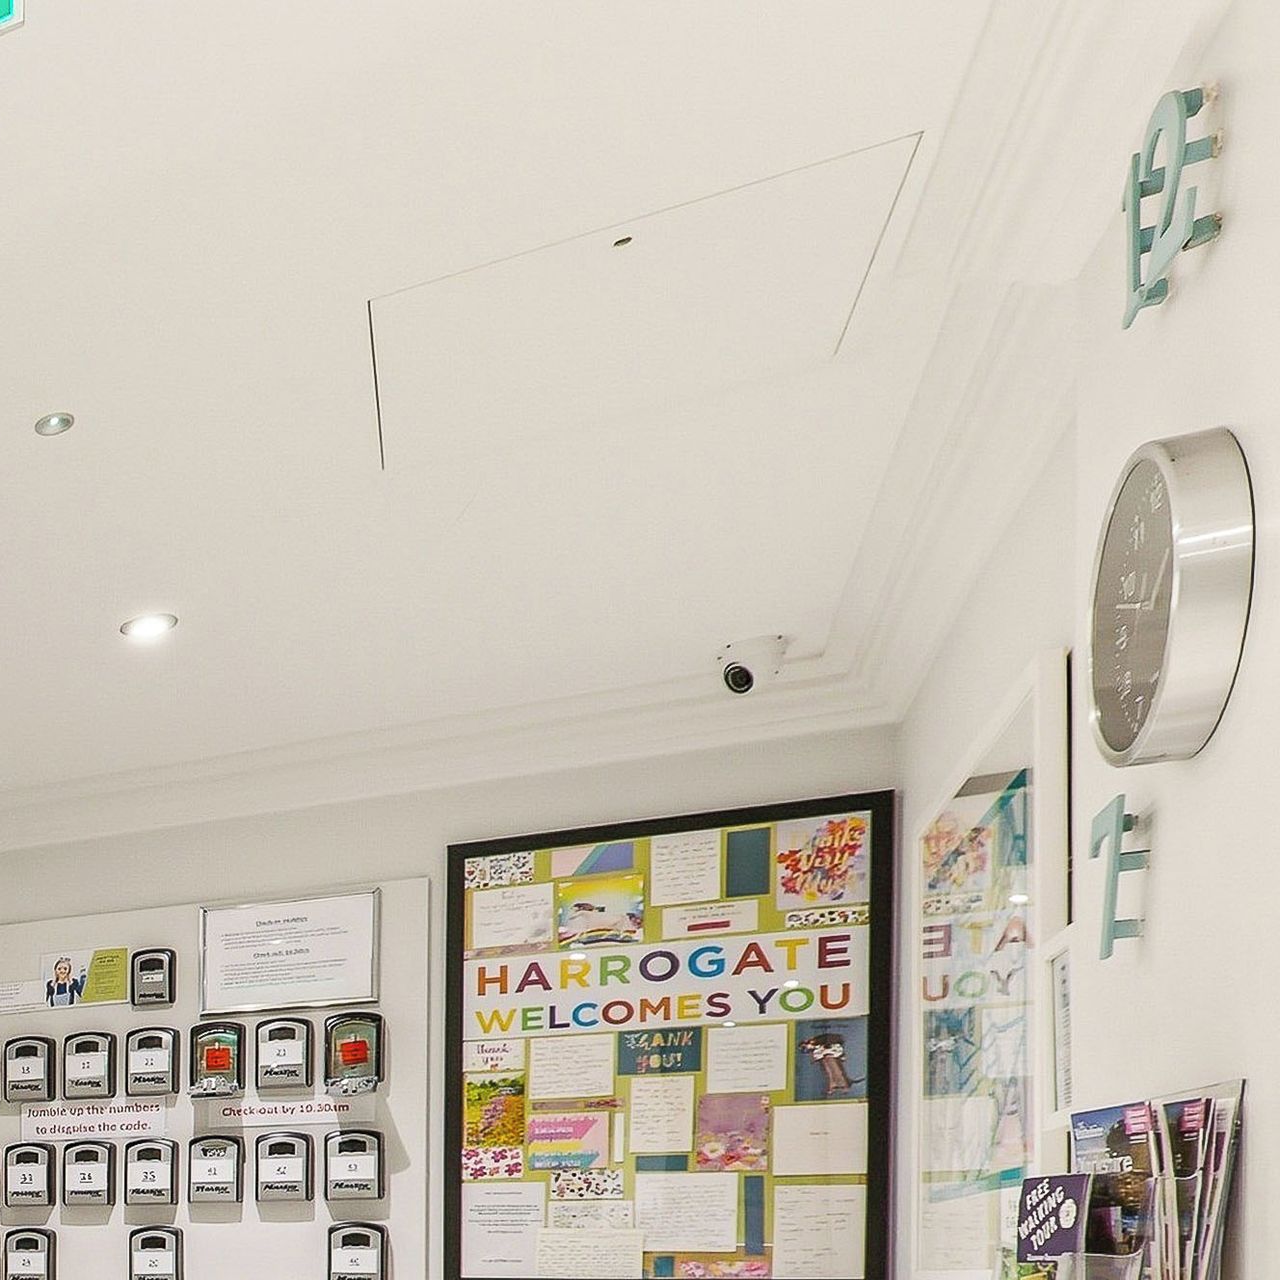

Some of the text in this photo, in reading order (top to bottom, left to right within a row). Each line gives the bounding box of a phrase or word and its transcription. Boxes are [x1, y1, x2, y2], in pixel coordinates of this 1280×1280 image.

[476, 934, 852, 996] HARROGATE
[475, 982, 851, 1035] WELCOMES YOU
[27, 1102, 160, 1118] Jumble up the numbers
[36, 1126, 47, 1135] to
[98, 1122, 116, 1131] the
[1030, 1216, 1058, 1251] TOUR
